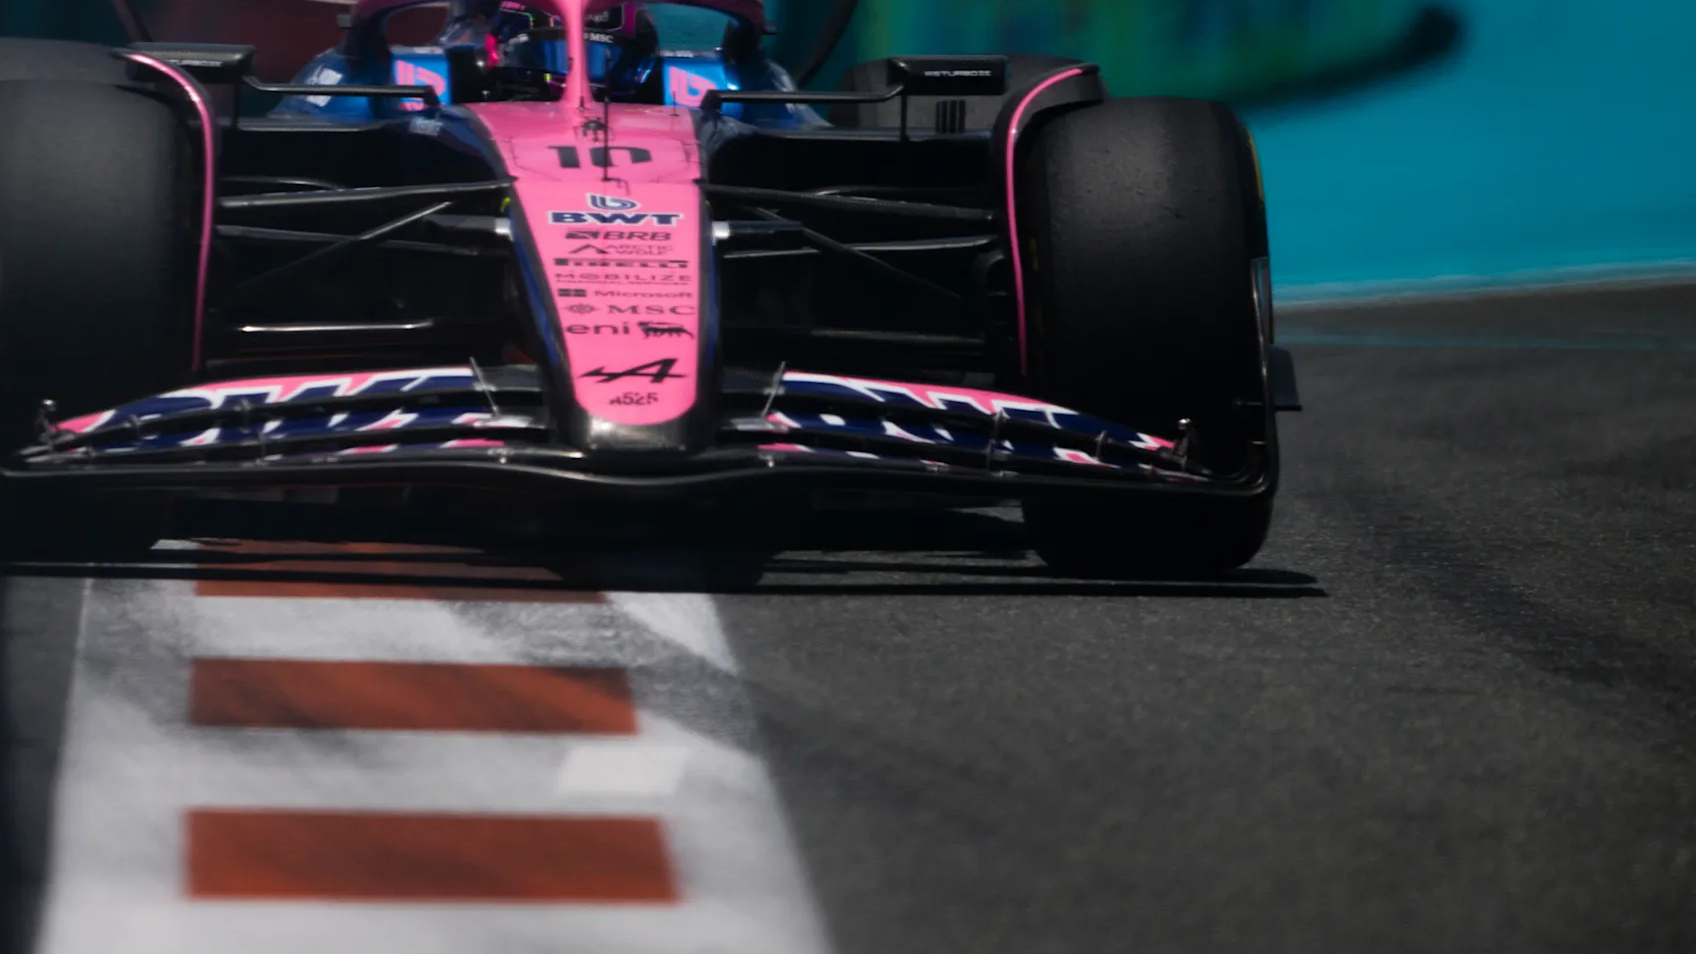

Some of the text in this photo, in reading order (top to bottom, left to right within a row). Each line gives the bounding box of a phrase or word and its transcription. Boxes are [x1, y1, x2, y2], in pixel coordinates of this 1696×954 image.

[550, 211, 682, 226] BWT
[554, 273, 692, 282] MOBILIZE
[607, 305, 696, 315] MSC
[565, 321, 630, 335] eni
